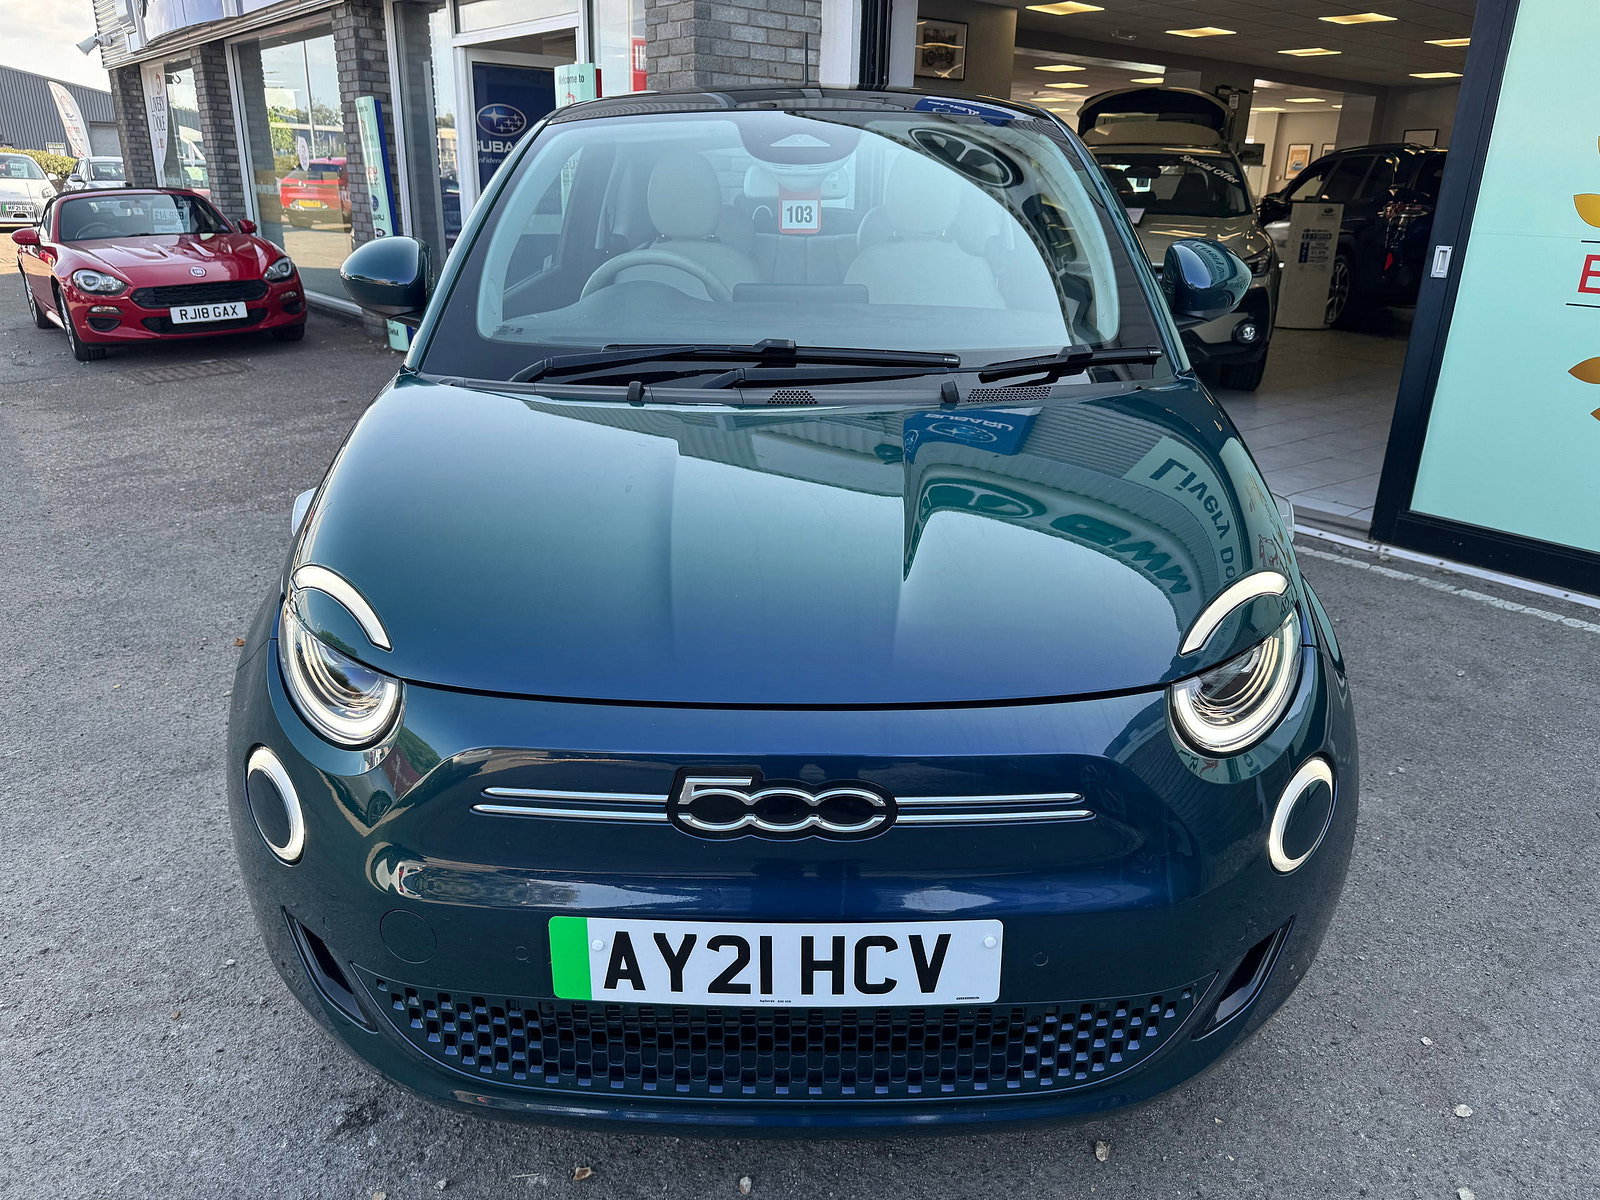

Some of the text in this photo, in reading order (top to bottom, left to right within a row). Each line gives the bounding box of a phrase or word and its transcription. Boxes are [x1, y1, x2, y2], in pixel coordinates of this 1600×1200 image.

[578, 74, 585, 83] to
[1180, 155, 1241, 184] Special Offer
[786, 205, 813, 223] 103
[179, 304, 238, 320] RJ18 GAX
[677, 776, 887, 833] 500
[603, 930, 952, 995] AY21 HCV
